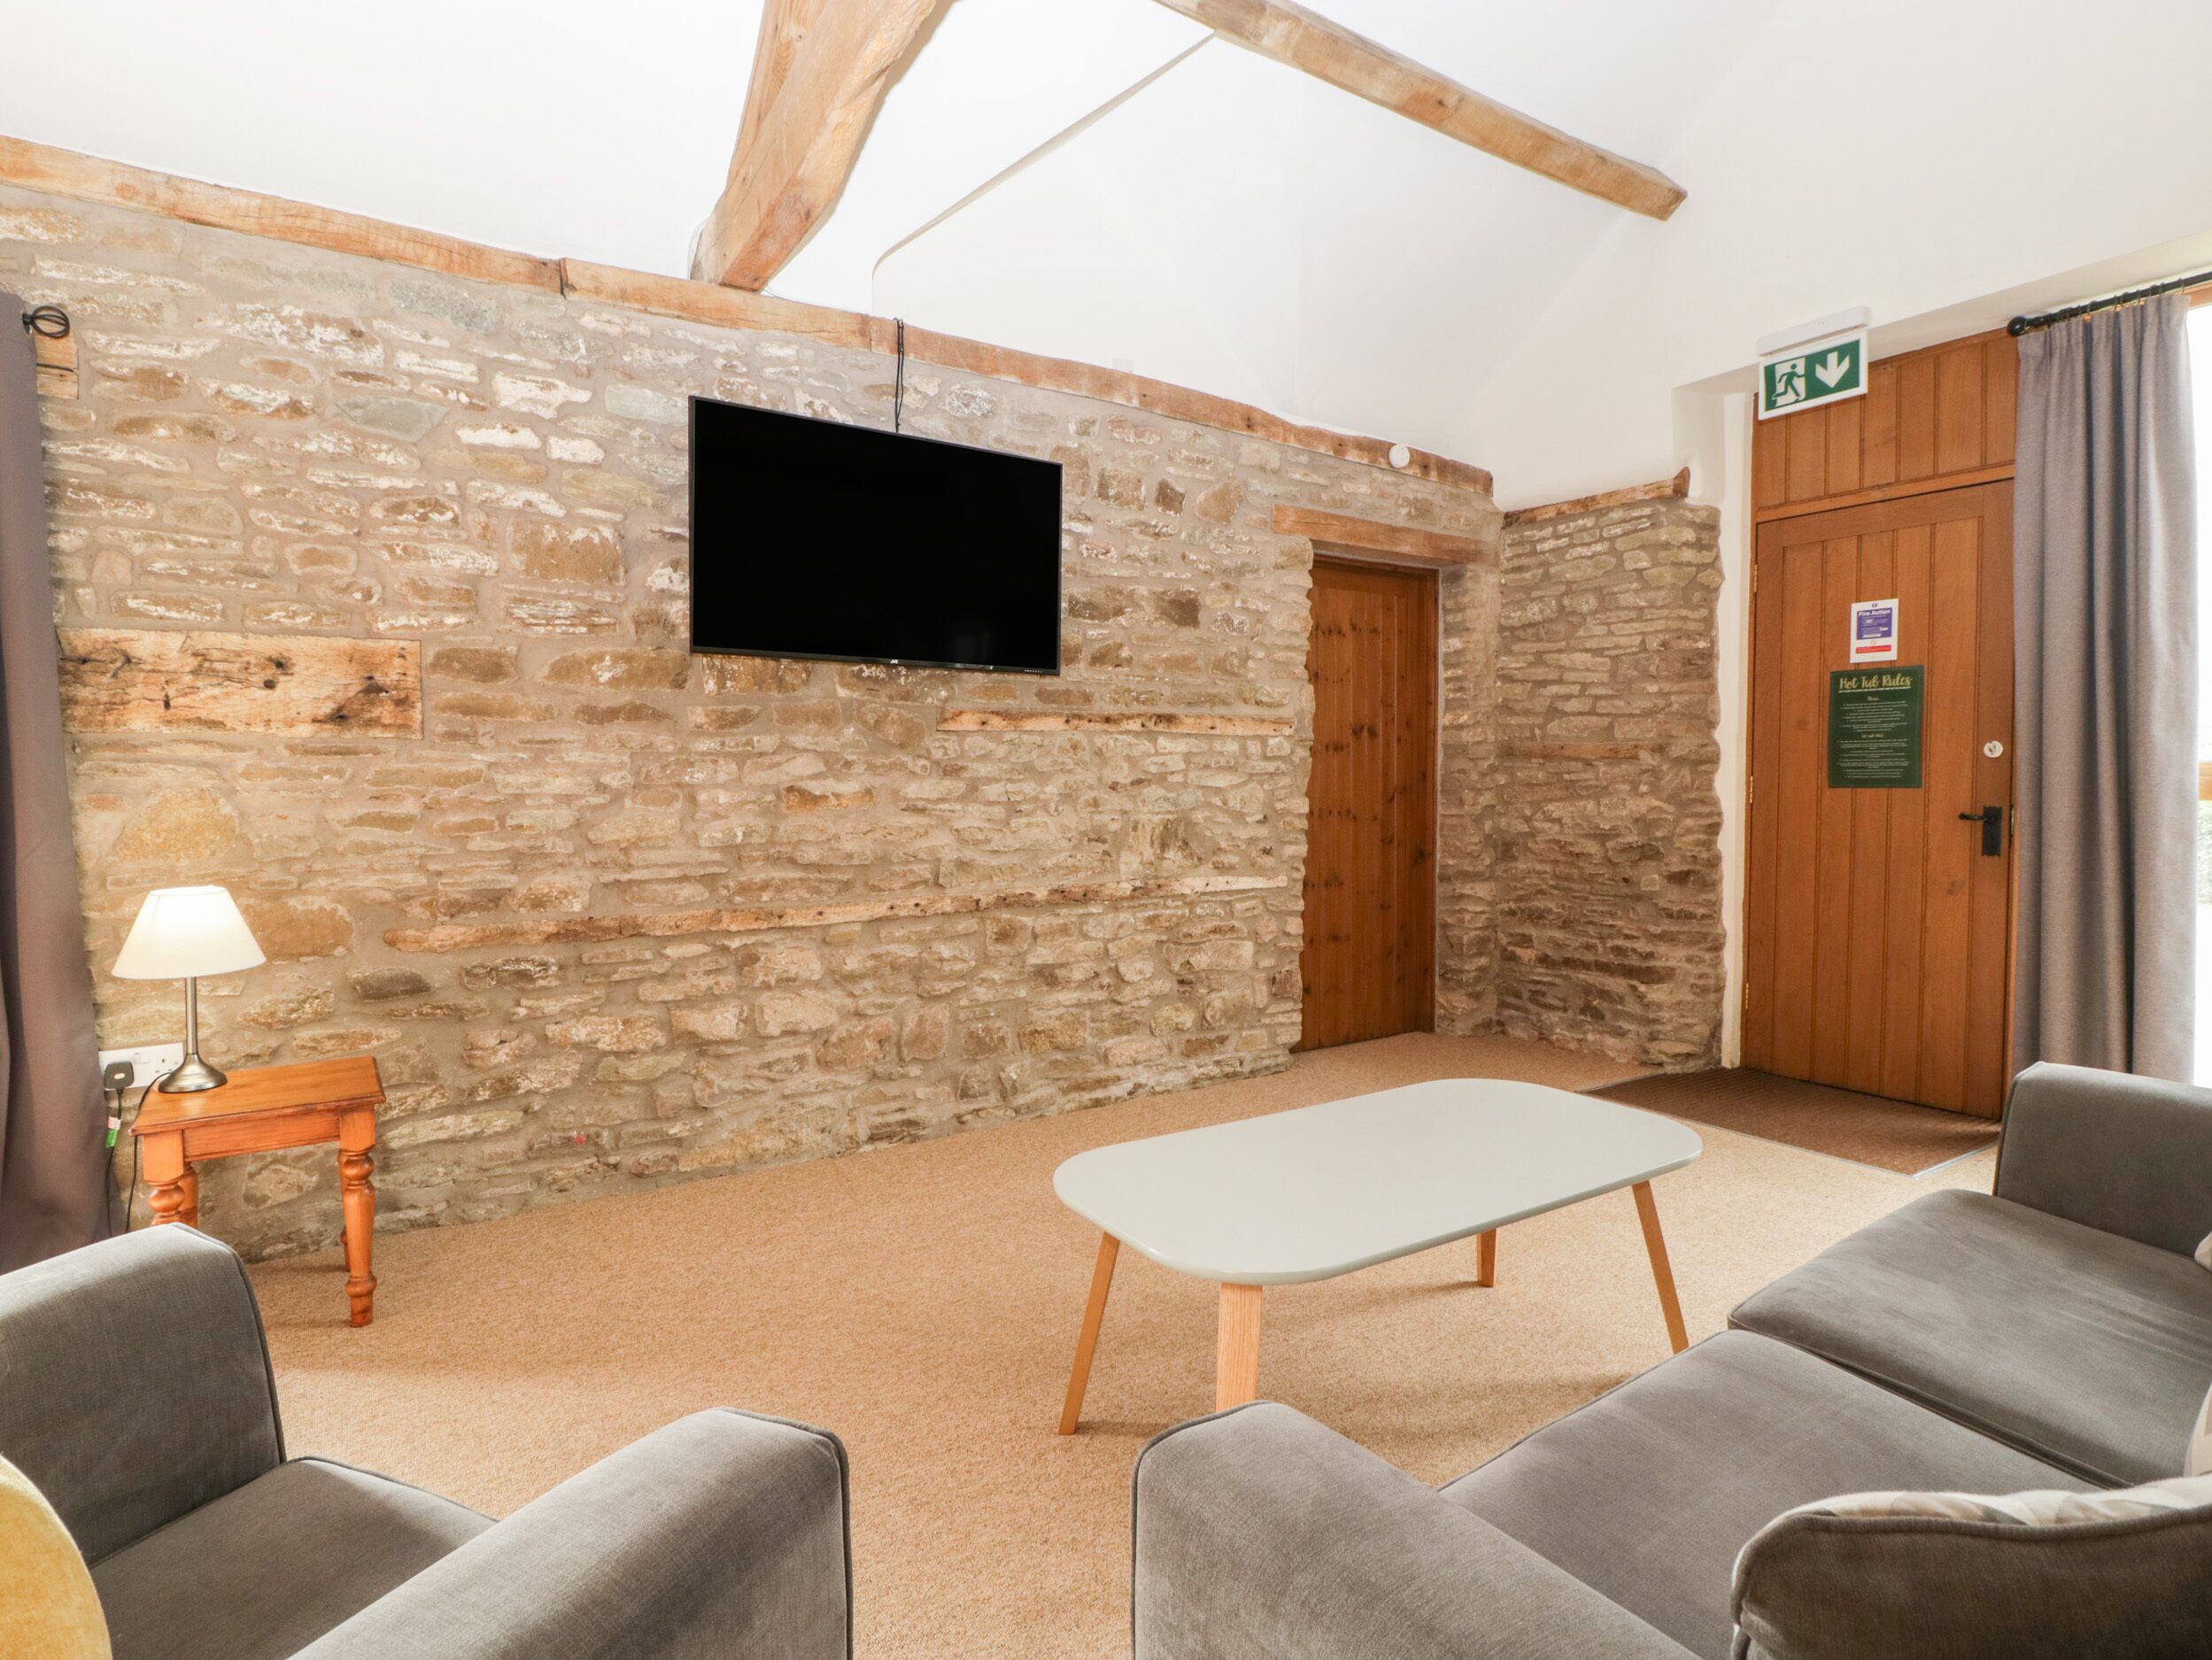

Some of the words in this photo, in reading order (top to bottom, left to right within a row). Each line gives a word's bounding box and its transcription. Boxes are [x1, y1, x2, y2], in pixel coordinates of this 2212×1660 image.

[1839, 677, 1859, 689] Hot
[1860, 675, 1880, 688] Tub
[1883, 673, 1912, 686] Rules
